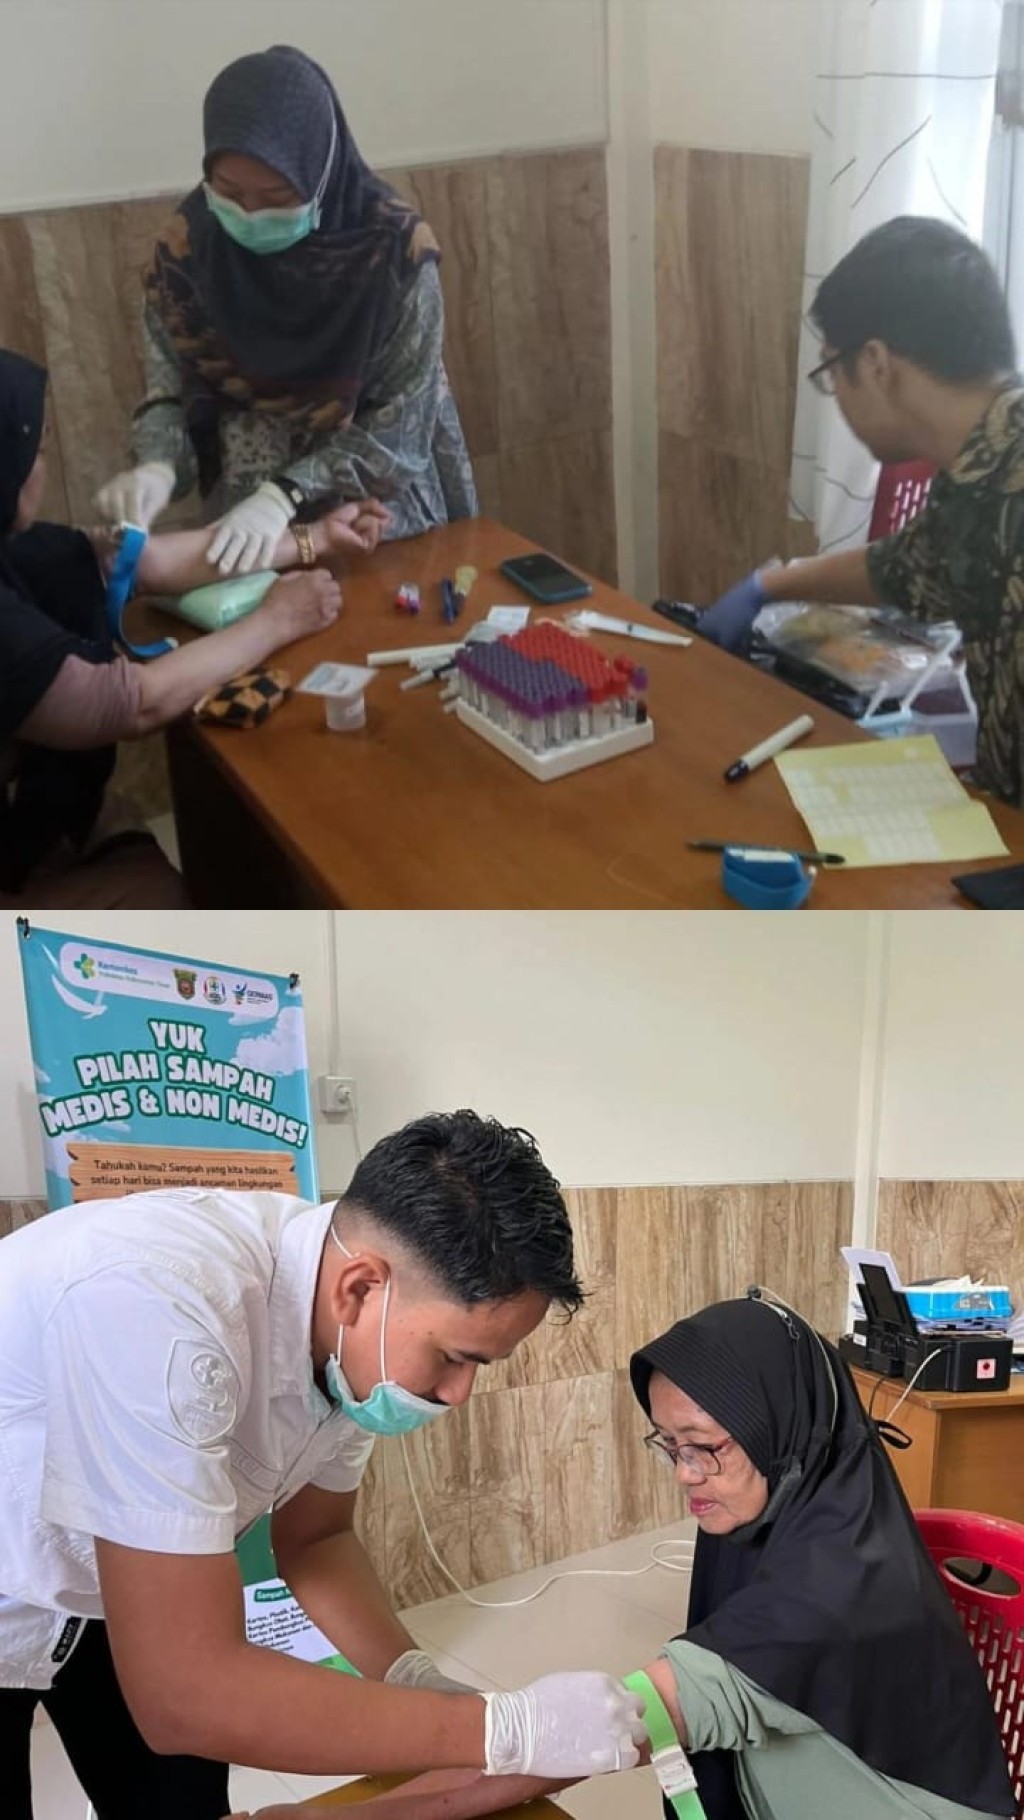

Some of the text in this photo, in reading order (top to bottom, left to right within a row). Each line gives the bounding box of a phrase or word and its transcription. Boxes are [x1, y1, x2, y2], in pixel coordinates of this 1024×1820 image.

[150, 1019, 206, 1053] YUK
[75, 1053, 274, 1101] PILAH SAMPAH
[41, 1087, 308, 1148] MEDIS & NON MEDIS!
[91, 1175, 284, 1190] setiap hari bisa menjadi ancaman lingkungan
[94, 1160, 278, 1176] Tahukah kamu? Sampah yang kita hasilkan
